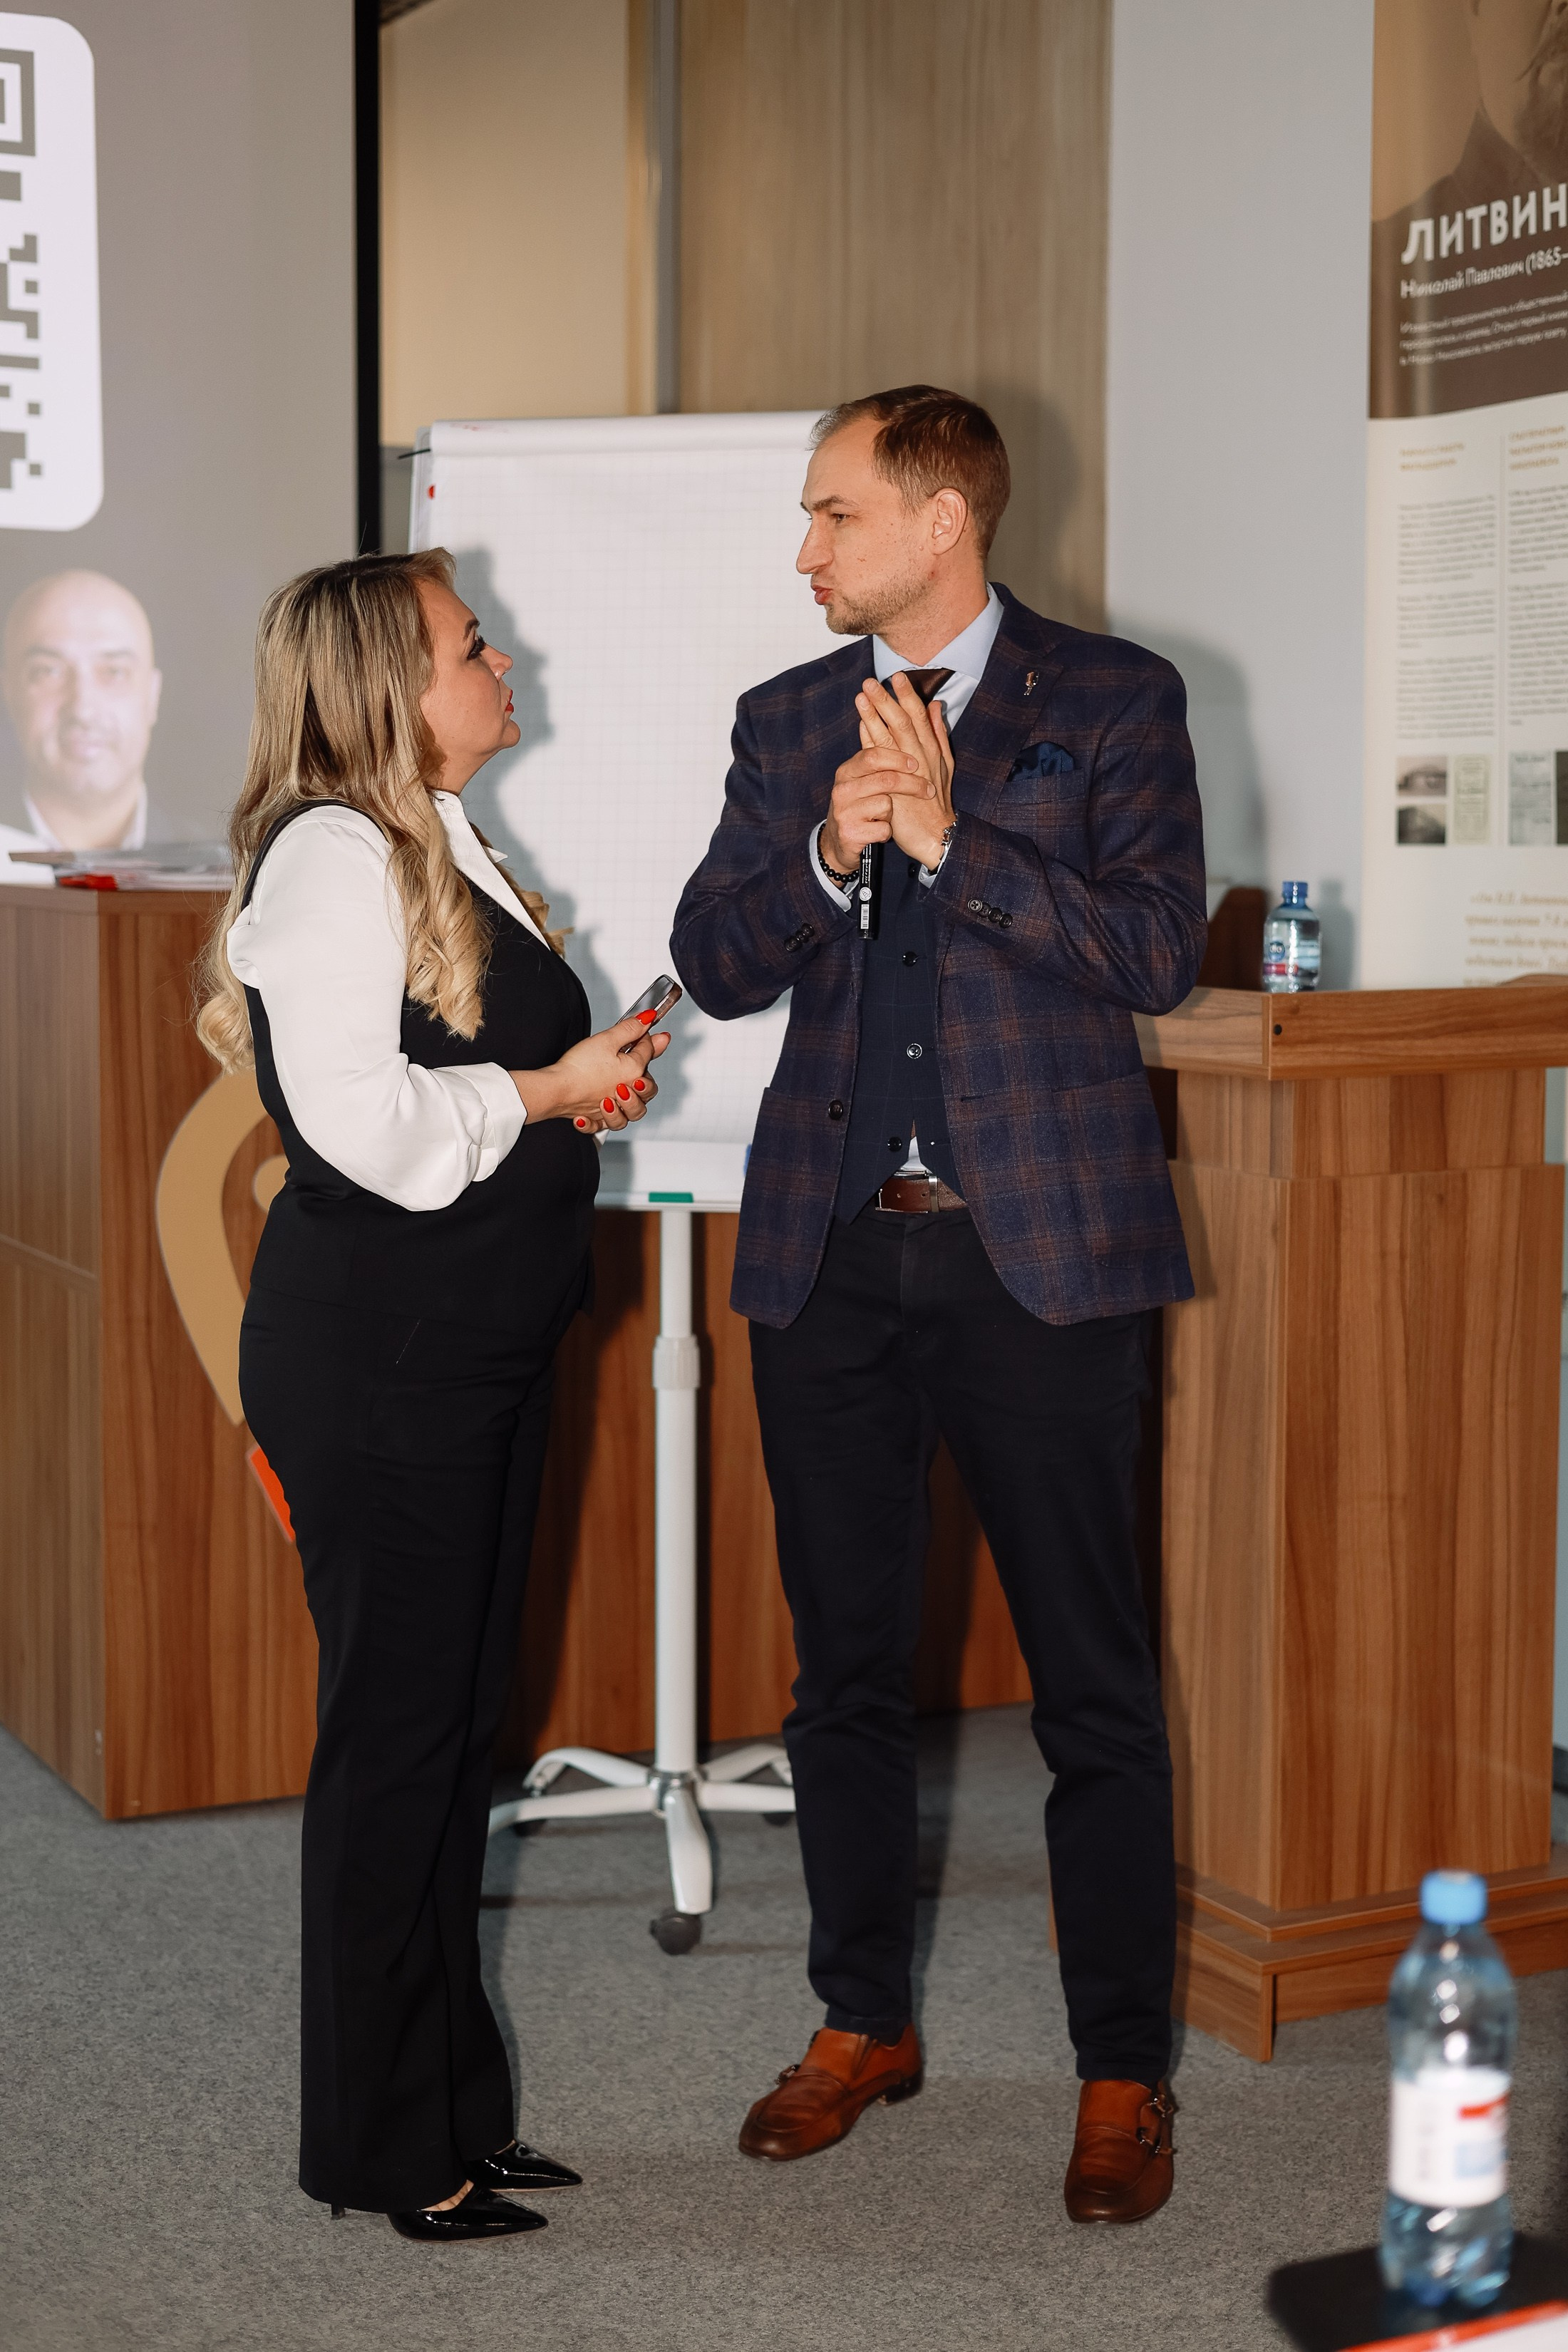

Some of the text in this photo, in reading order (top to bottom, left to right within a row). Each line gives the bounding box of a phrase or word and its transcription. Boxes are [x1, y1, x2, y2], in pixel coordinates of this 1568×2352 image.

[1401, 182, 1567, 265] ЛИТВИН
[1401, 270, 1465, 299] Николай
[1465, 260, 1525, 286] Павлович
